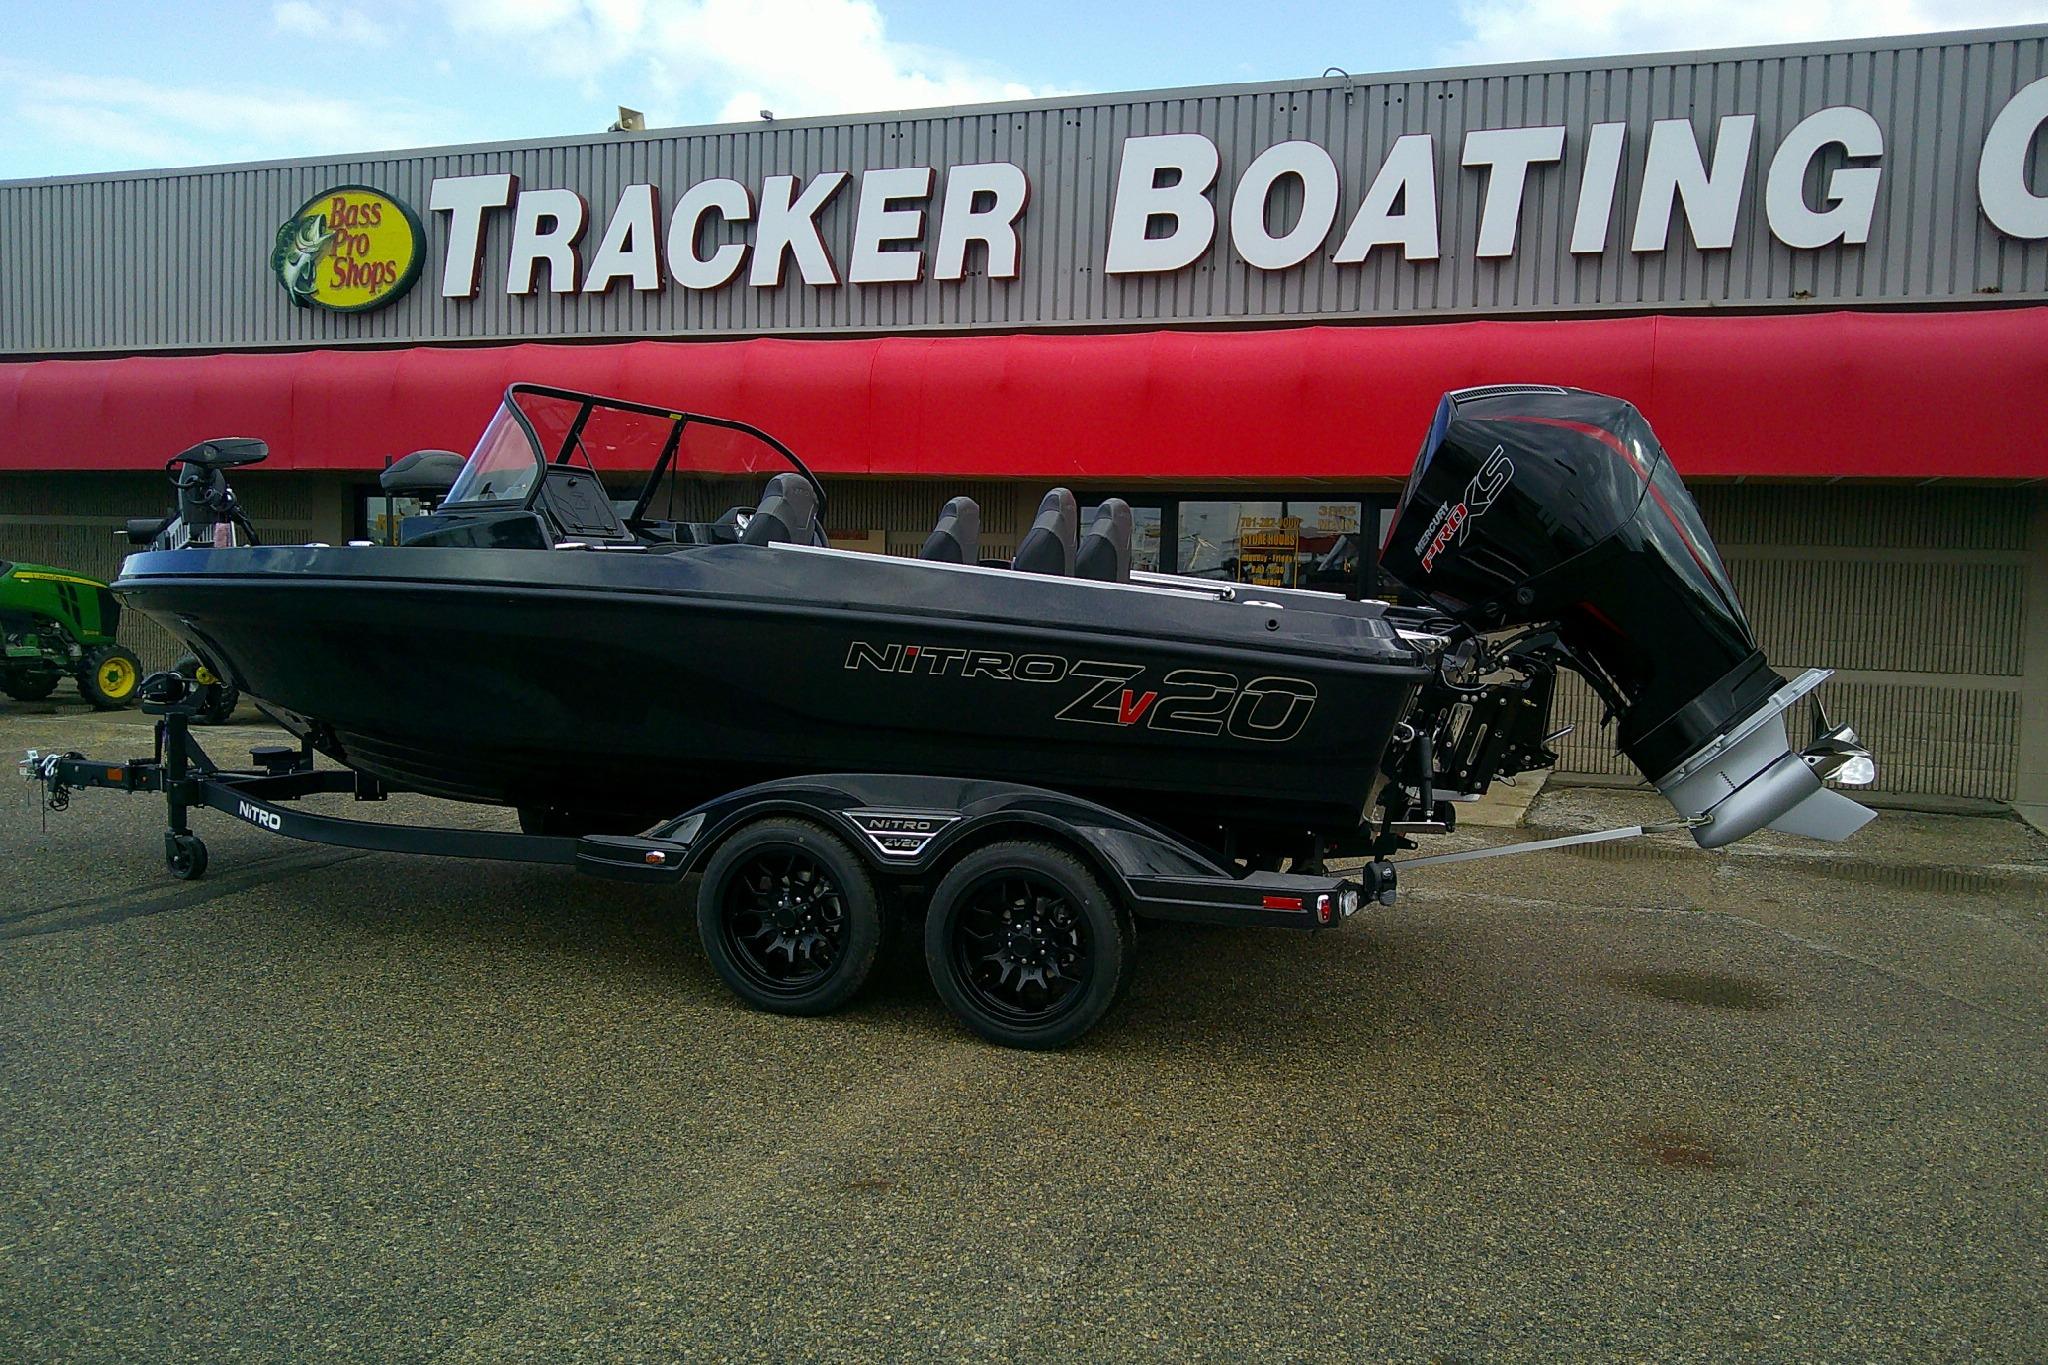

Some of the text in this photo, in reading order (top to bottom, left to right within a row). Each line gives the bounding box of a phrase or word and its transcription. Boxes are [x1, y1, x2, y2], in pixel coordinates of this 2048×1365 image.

[328, 197, 382, 229] Bass
[430, 162, 1027, 298] TRACKER
[1105, 105, 1884, 275] BOATING
[329, 228, 370, 257] Pro
[330, 256, 397, 295] Shops
[1267, 533, 1295, 546] HOURS
[1414, 500, 1449, 556] MERCURY
